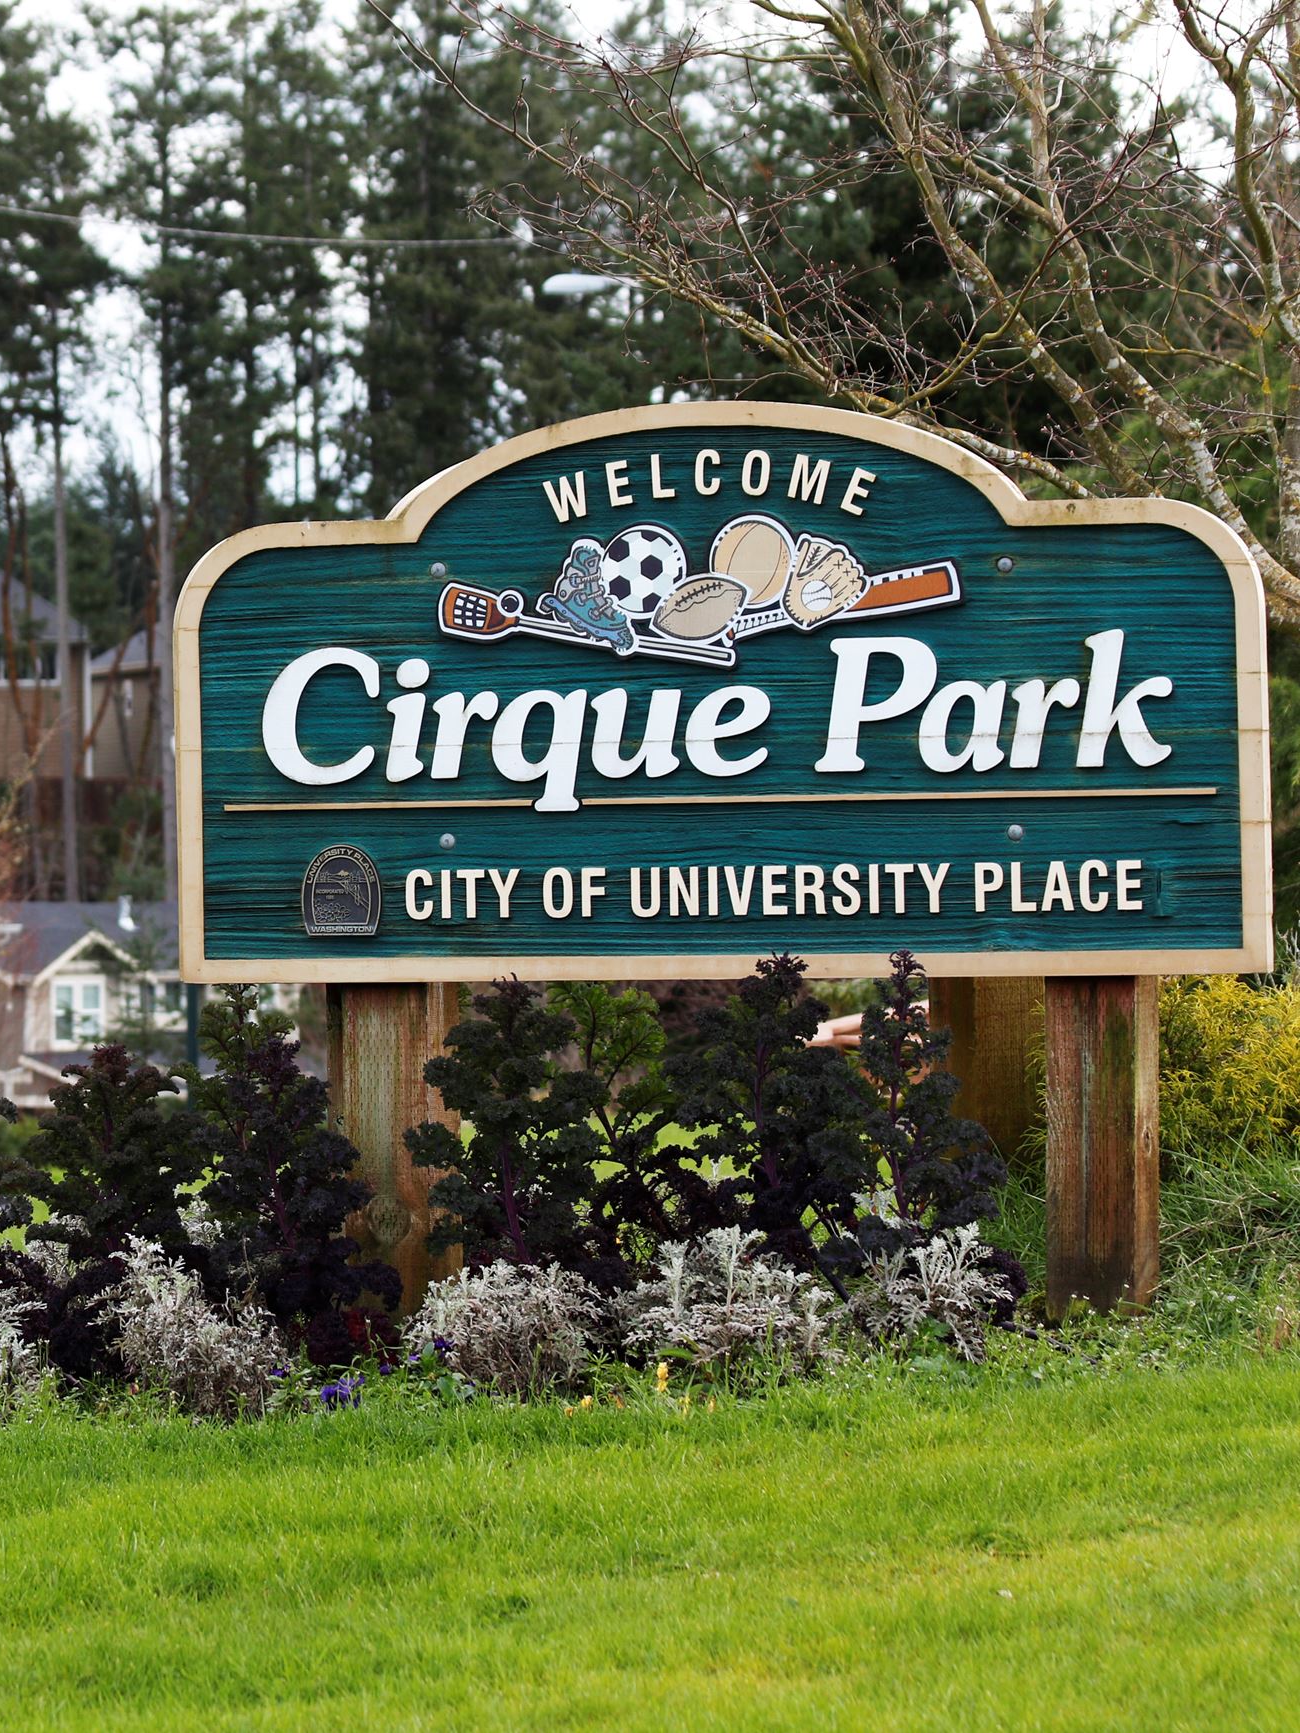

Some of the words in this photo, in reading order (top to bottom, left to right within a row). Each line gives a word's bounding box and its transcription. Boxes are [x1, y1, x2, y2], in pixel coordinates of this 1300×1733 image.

[542, 447, 877, 523] WELCOME
[262, 646, 771, 812] Cirque
[814, 628, 1174, 774] Park
[306, 847, 353, 884] UNIVERSITY
[353, 852, 376, 884] PLACE
[404, 868, 521, 921] CITY
[542, 867, 607, 919] OF
[629, 862, 951, 919] UNIVERSITY
[974, 859, 1144, 913] PLACE
[311, 925, 373, 933] WASHINGTON
